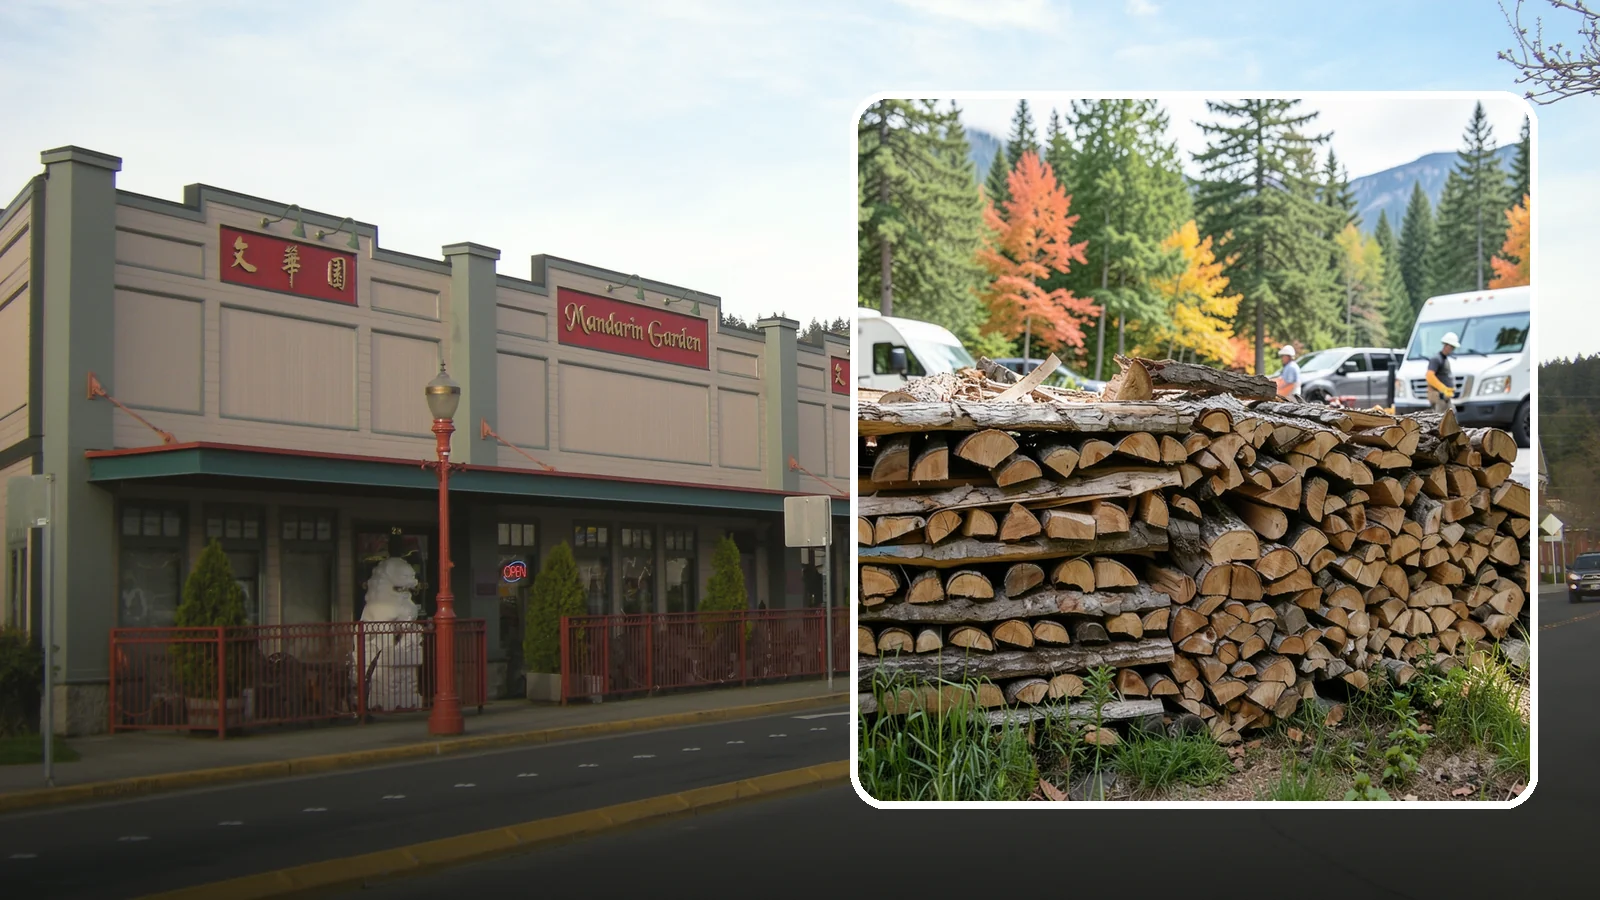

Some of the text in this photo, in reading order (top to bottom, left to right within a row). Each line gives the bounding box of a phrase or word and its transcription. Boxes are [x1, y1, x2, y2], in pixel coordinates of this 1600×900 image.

[230, 235, 346, 290] 文華園
[564, 302, 702, 352] Mandarin Garden
[503, 565, 526, 578] OPEN
